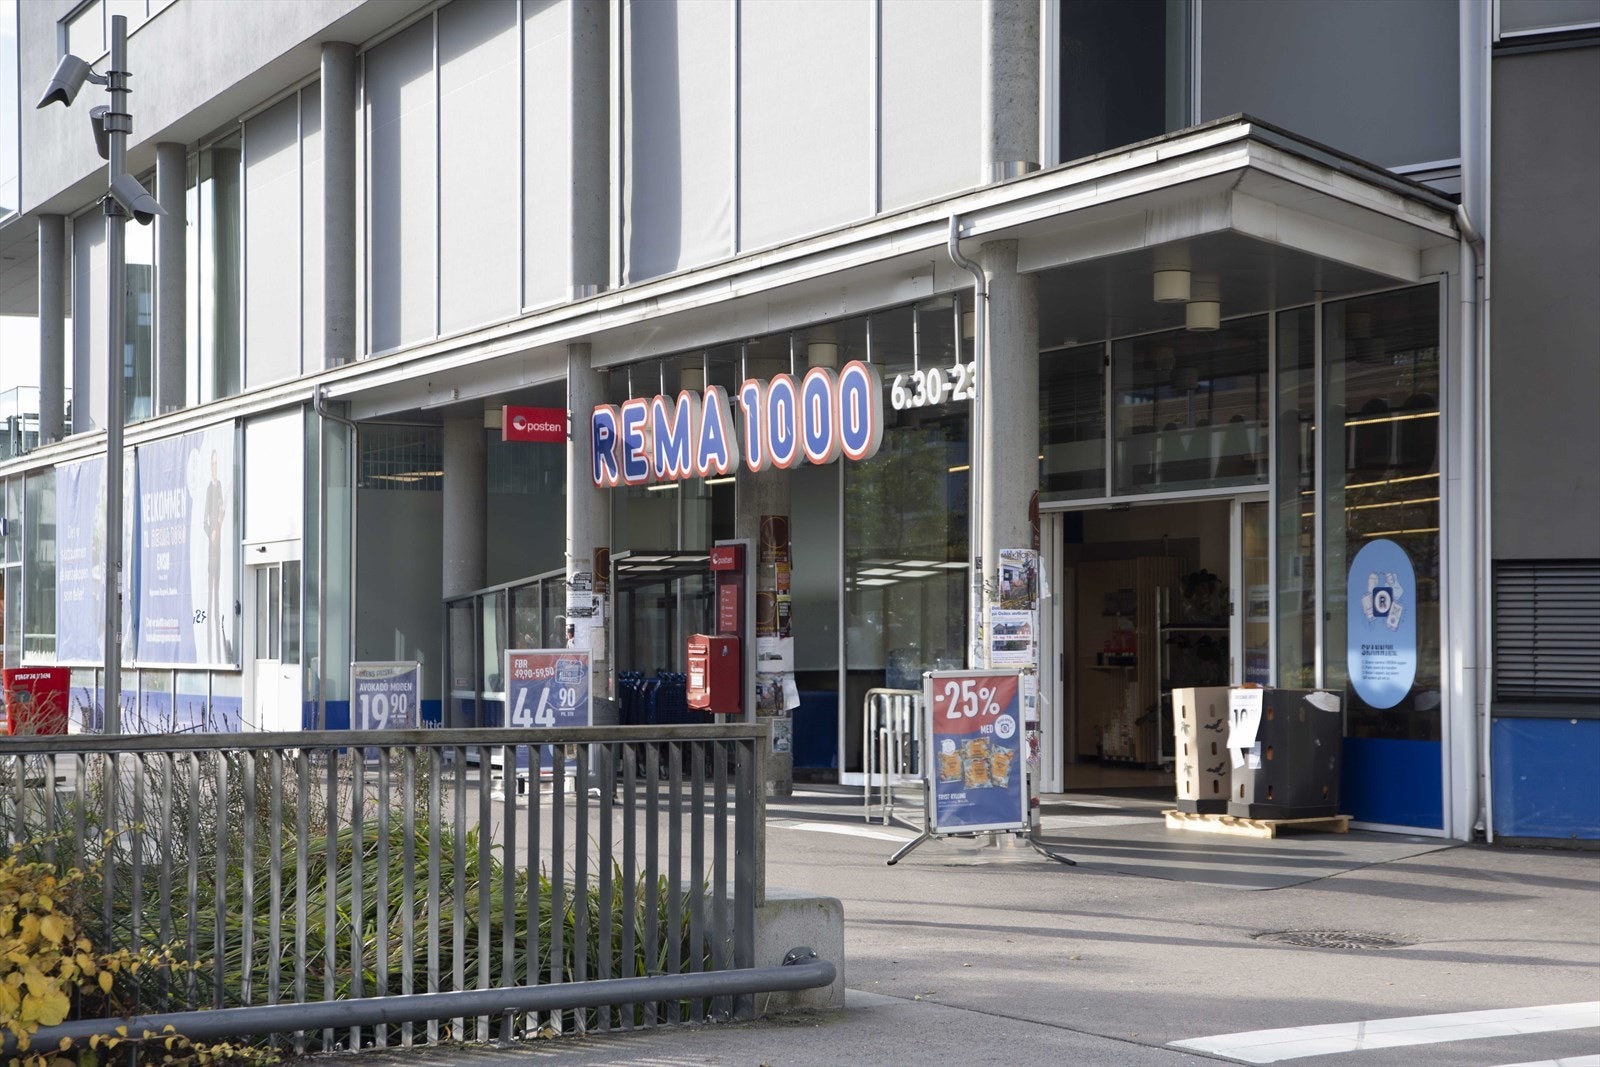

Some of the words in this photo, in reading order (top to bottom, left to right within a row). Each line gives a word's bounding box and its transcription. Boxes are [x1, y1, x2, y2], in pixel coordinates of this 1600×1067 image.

[891, 361, 976, 411] 6.30-23
[527, 421, 562, 433] posten
[590, 385, 734, 488] REMA
[740, 360, 877, 474] 1000
[514, 659, 528, 668] FØR
[359, 682, 389, 692] AVOKADO
[935, 679, 1001, 719] -25%
[360, 693, 389, 731] 19
[390, 693, 407, 714] 90
[512, 687, 556, 729] 44
[559, 688, 576, 707] 90
[980, 724, 994, 735] MED
